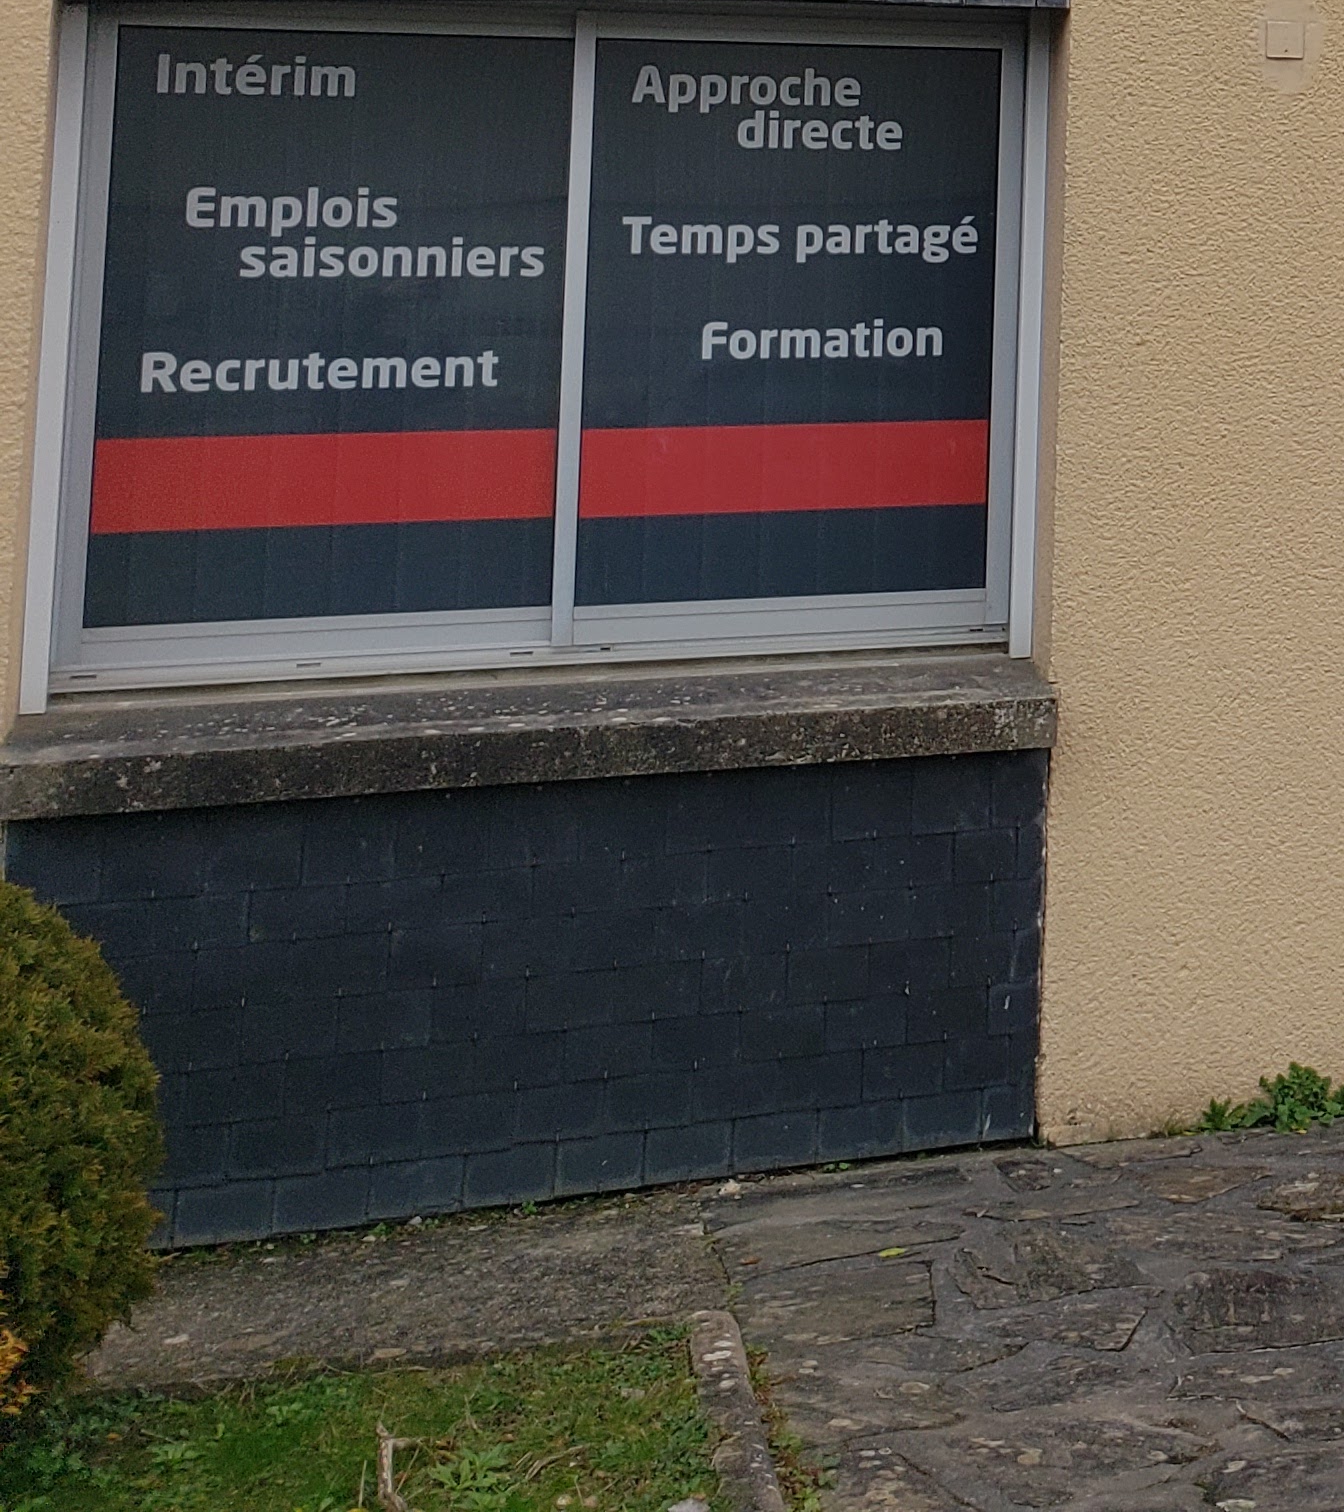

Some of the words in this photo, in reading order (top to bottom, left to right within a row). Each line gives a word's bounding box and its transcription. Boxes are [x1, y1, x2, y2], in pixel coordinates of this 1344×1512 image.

[155, 52, 357, 100] Intérim
[631, 63, 863, 114] Approche
[736, 109, 905, 152] directe
[186, 186, 400, 236] Emplois
[238, 232, 546, 281] saisonniers
[622, 214, 782, 266] Temps
[795, 213, 980, 266] partagé
[700, 318, 945, 363] Formation
[139, 349, 499, 396] Recrutement
